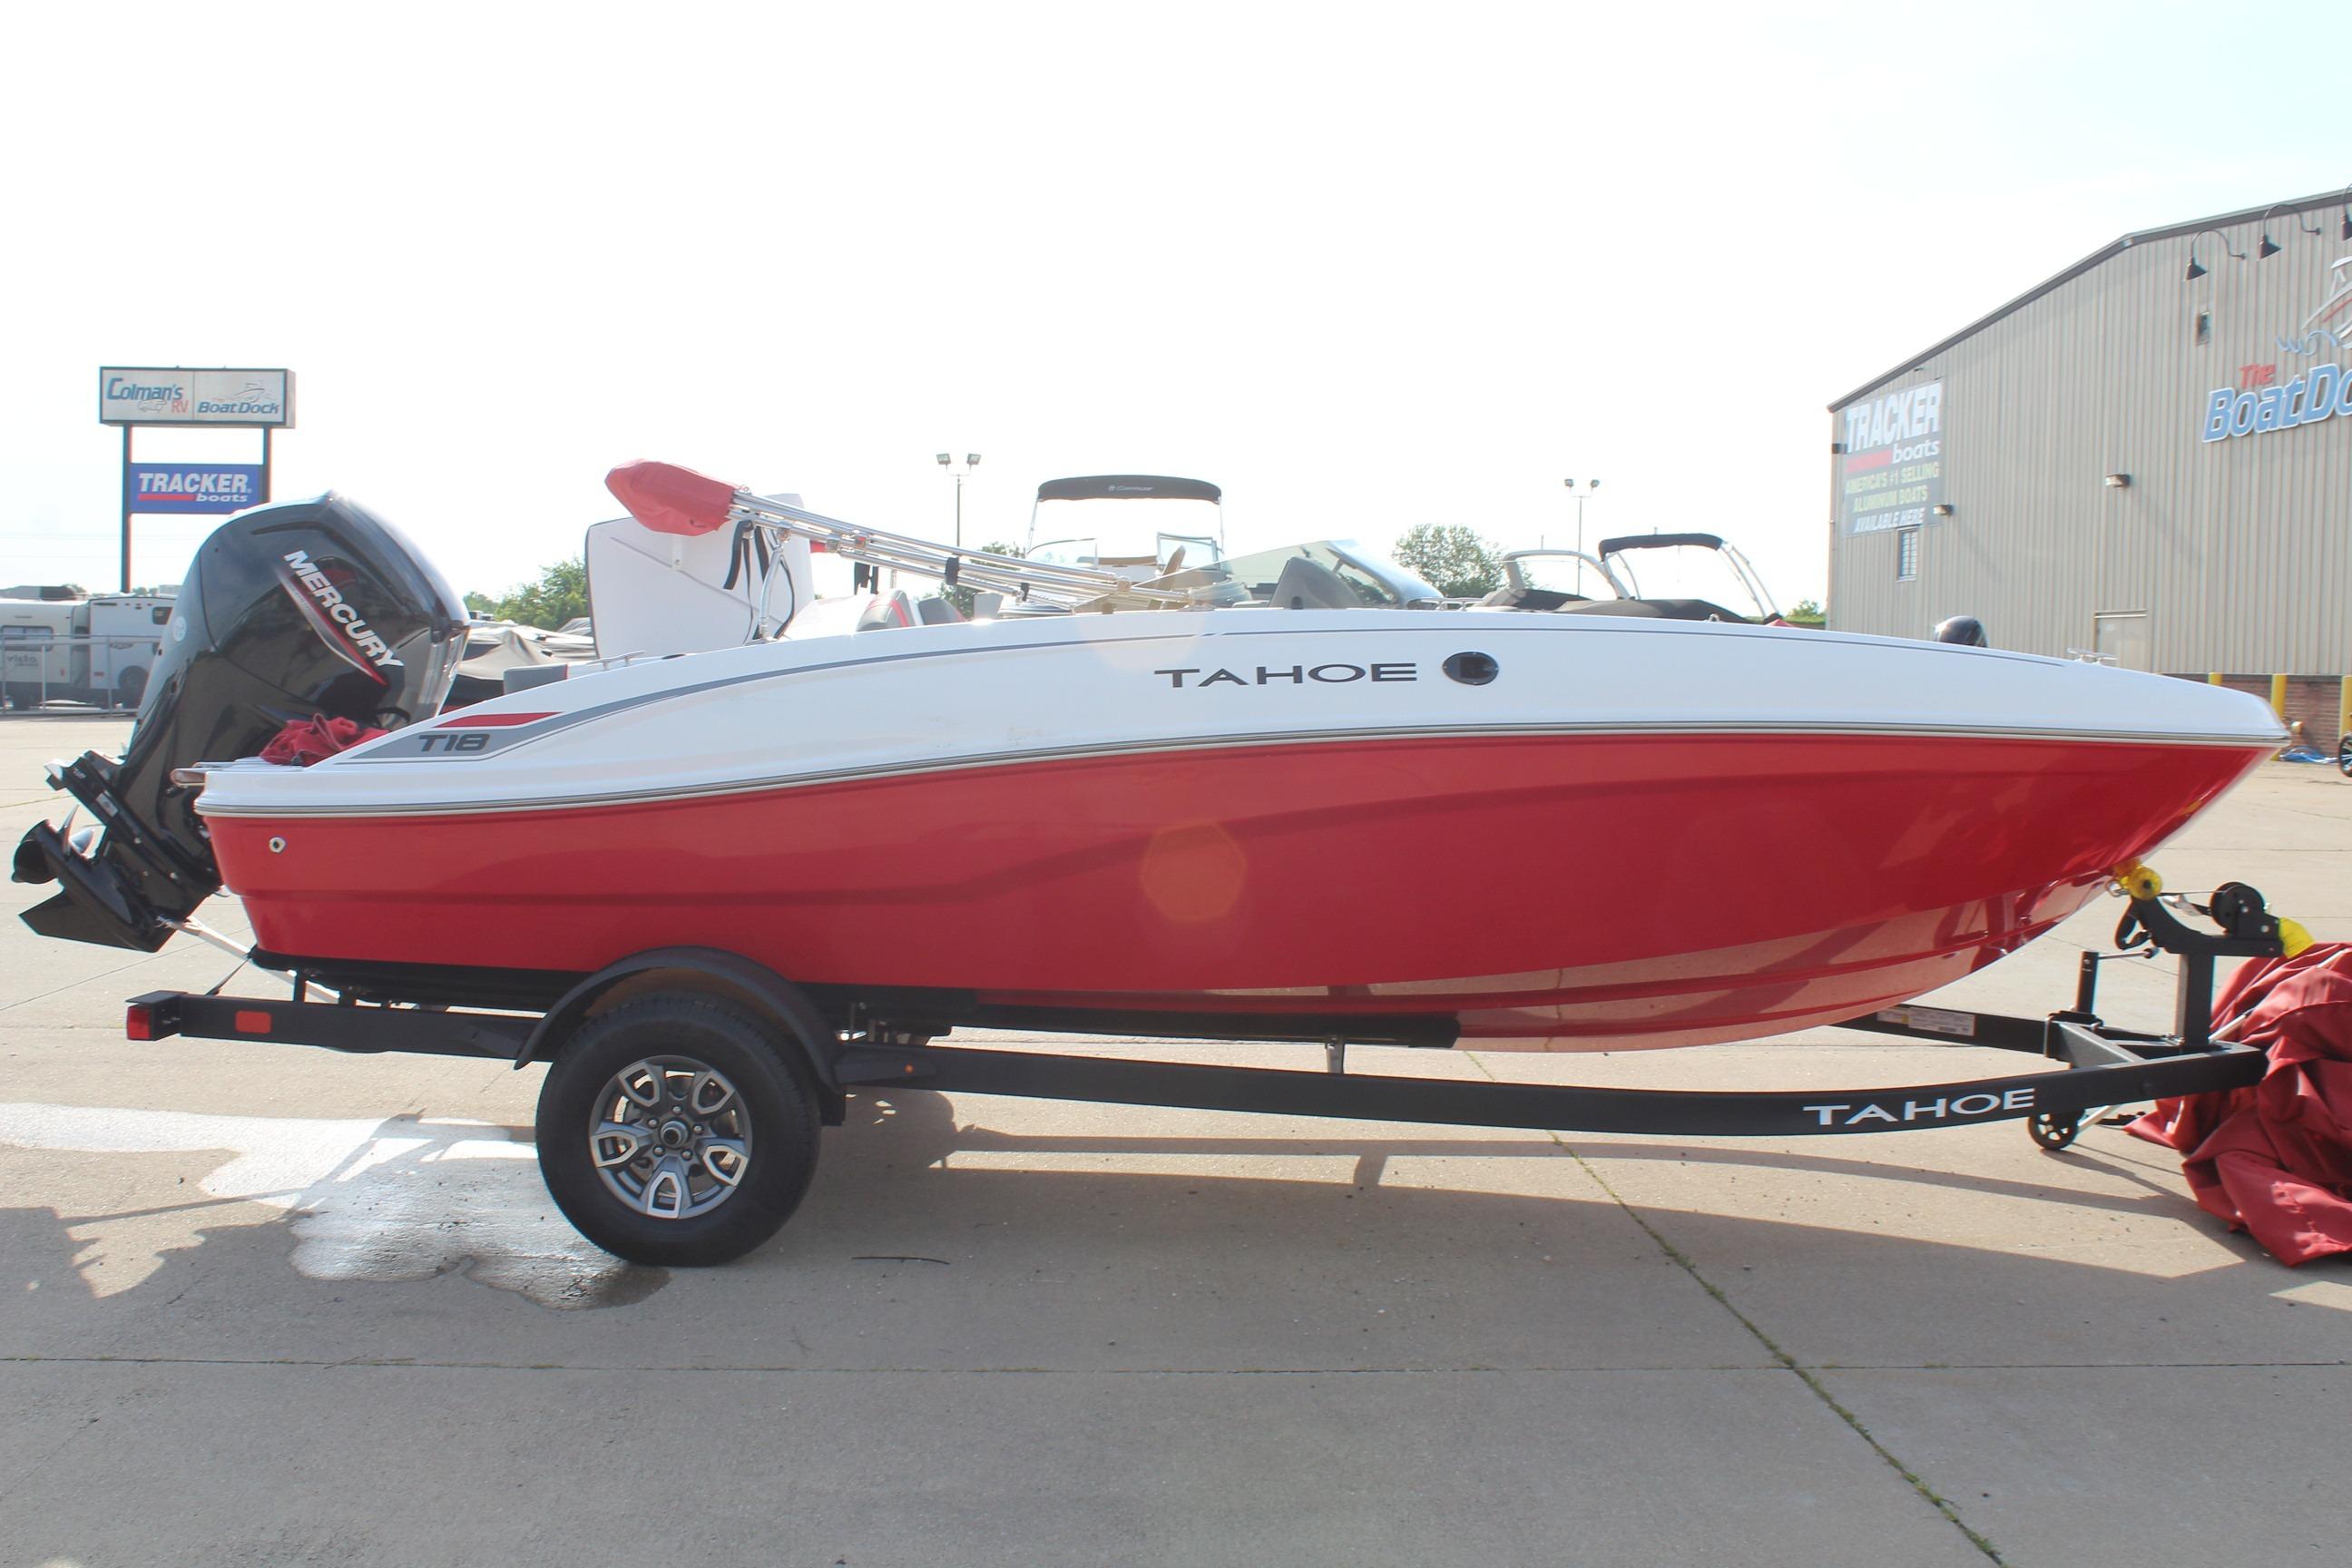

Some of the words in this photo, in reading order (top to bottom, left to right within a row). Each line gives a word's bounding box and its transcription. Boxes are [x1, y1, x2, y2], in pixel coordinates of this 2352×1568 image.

[105, 377, 184, 401] Colman's
[172, 400, 189, 414] RV
[1846, 382, 1943, 454] TRACKER
[1892, 440, 1940, 464] boats
[138, 472, 249, 494] TRACKER
[1901, 461, 1939, 484] SELLING
[196, 493, 248, 503] boats
[1898, 485, 1928, 505] BOATS
[1899, 507, 1926, 526] HERE
[283, 550, 406, 667] MERCURY
[1153, 662, 1417, 688] TAHOE
[418, 733, 490, 752] T18
[1802, 1088, 2035, 1126] TAHOE
